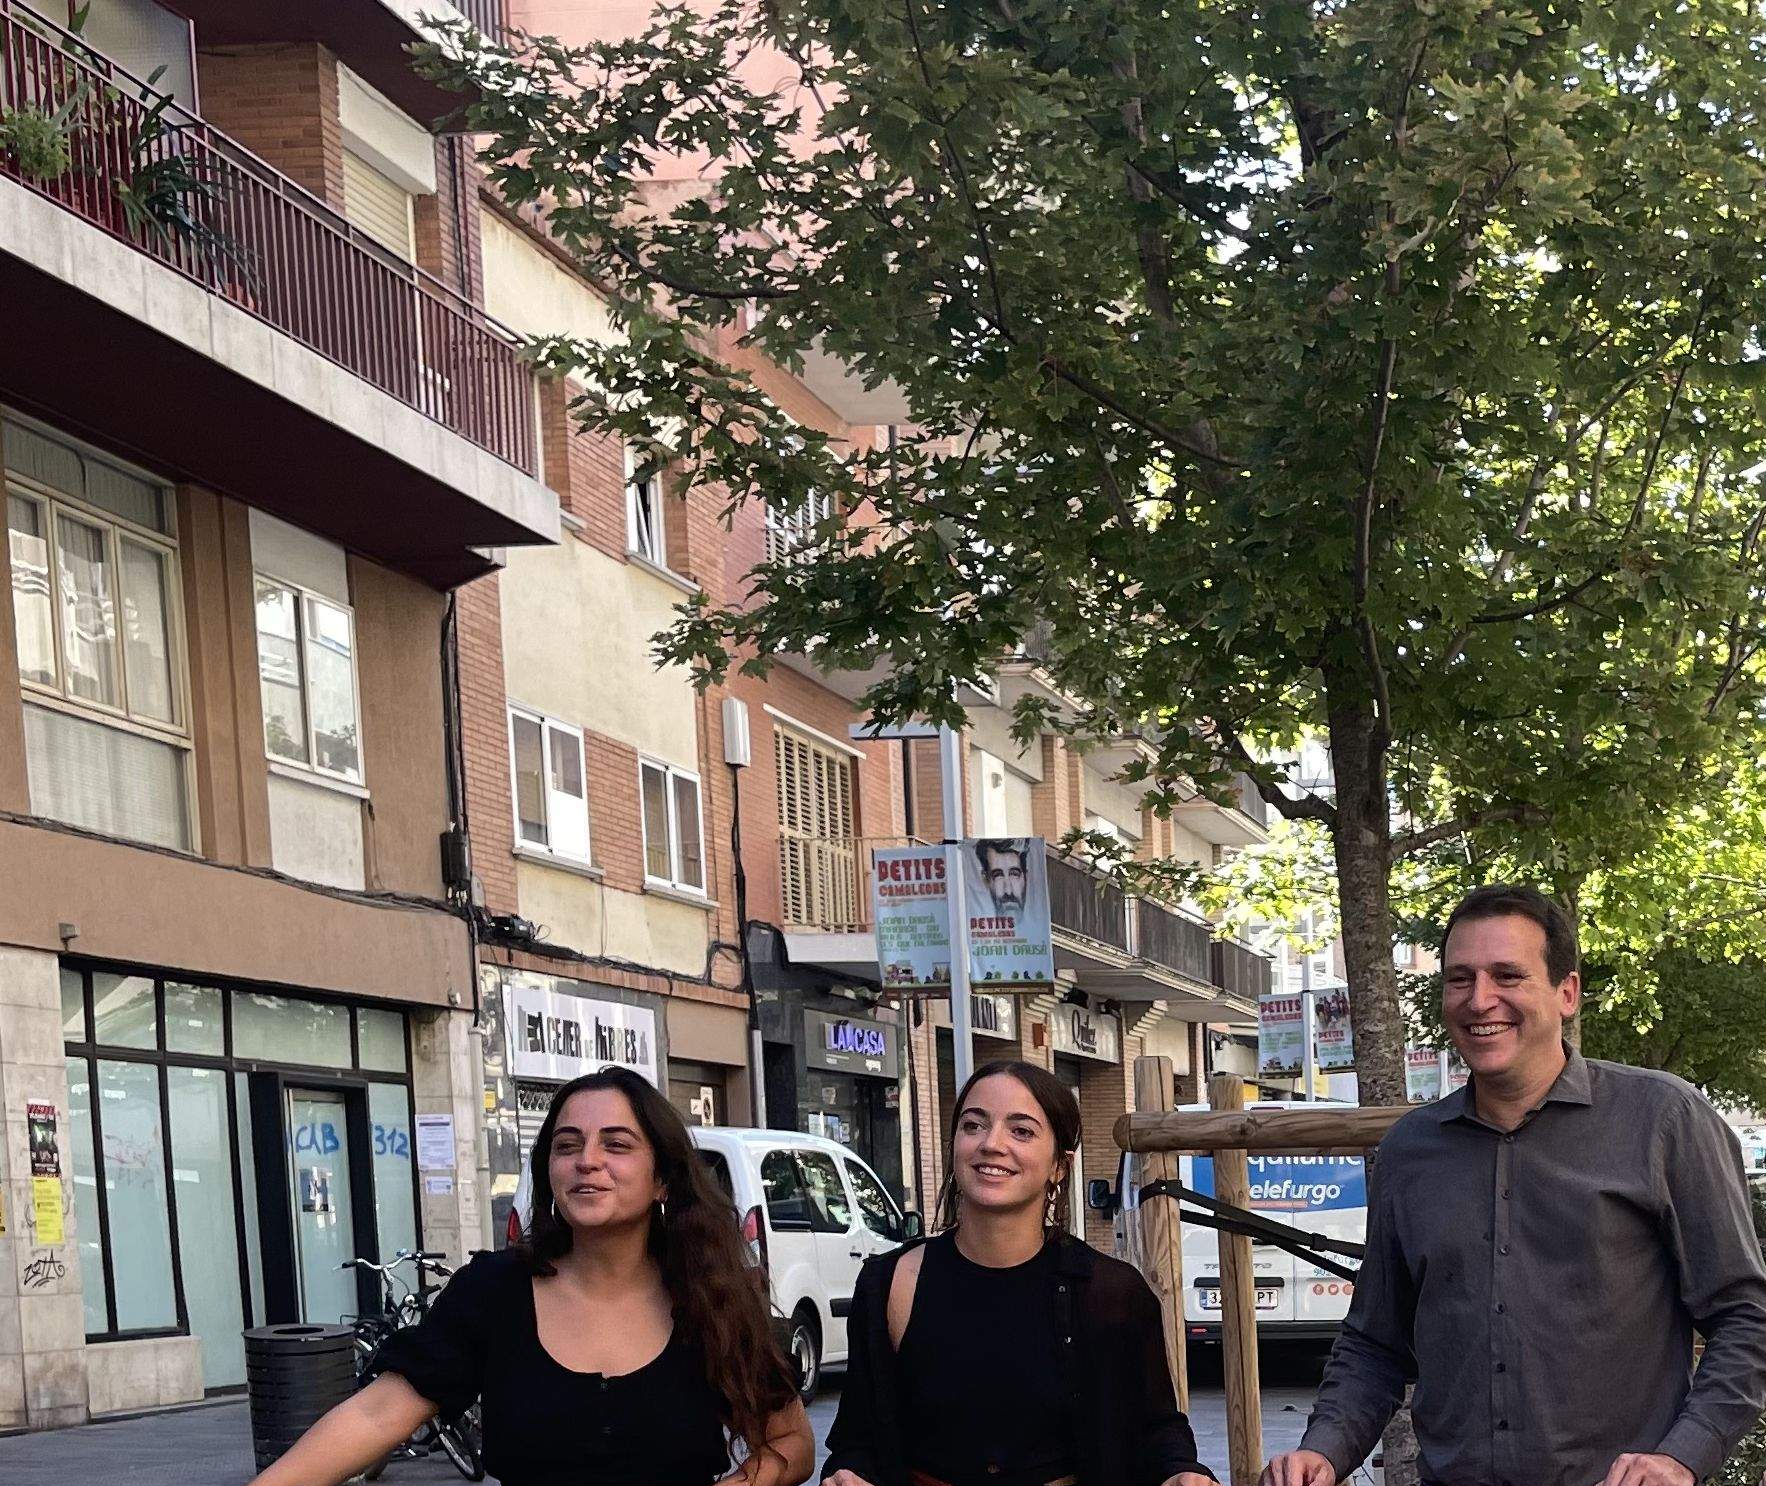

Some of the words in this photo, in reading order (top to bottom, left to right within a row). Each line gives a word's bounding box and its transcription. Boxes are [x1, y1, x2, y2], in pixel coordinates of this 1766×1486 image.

[878, 858, 945, 882] PETITS
[970, 917, 1015, 929] PETITS
[1250, 1180, 1341, 1205] elefurgo
